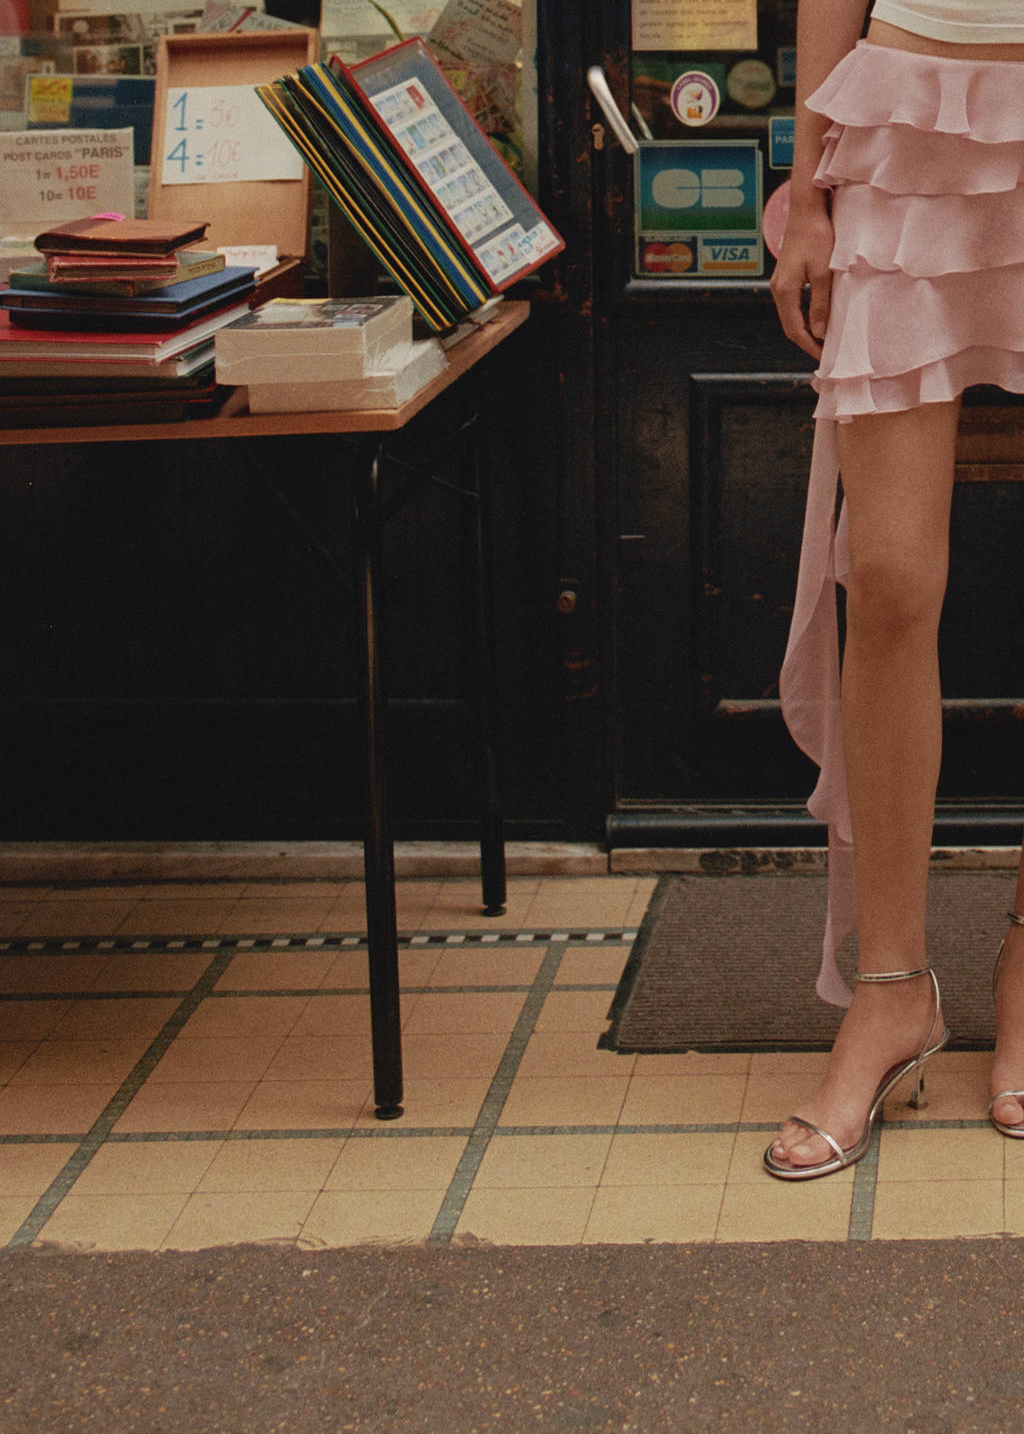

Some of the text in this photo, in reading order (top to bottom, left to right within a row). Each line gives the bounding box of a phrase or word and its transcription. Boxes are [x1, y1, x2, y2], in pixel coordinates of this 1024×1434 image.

[16, 133, 118, 147] CARTES POSTALES
[3, 152, 32, 162] POST
[34, 150, 73, 161] CARDS
[67, 185, 97, 200] 10E
[711, 247, 751, 261] VISA
